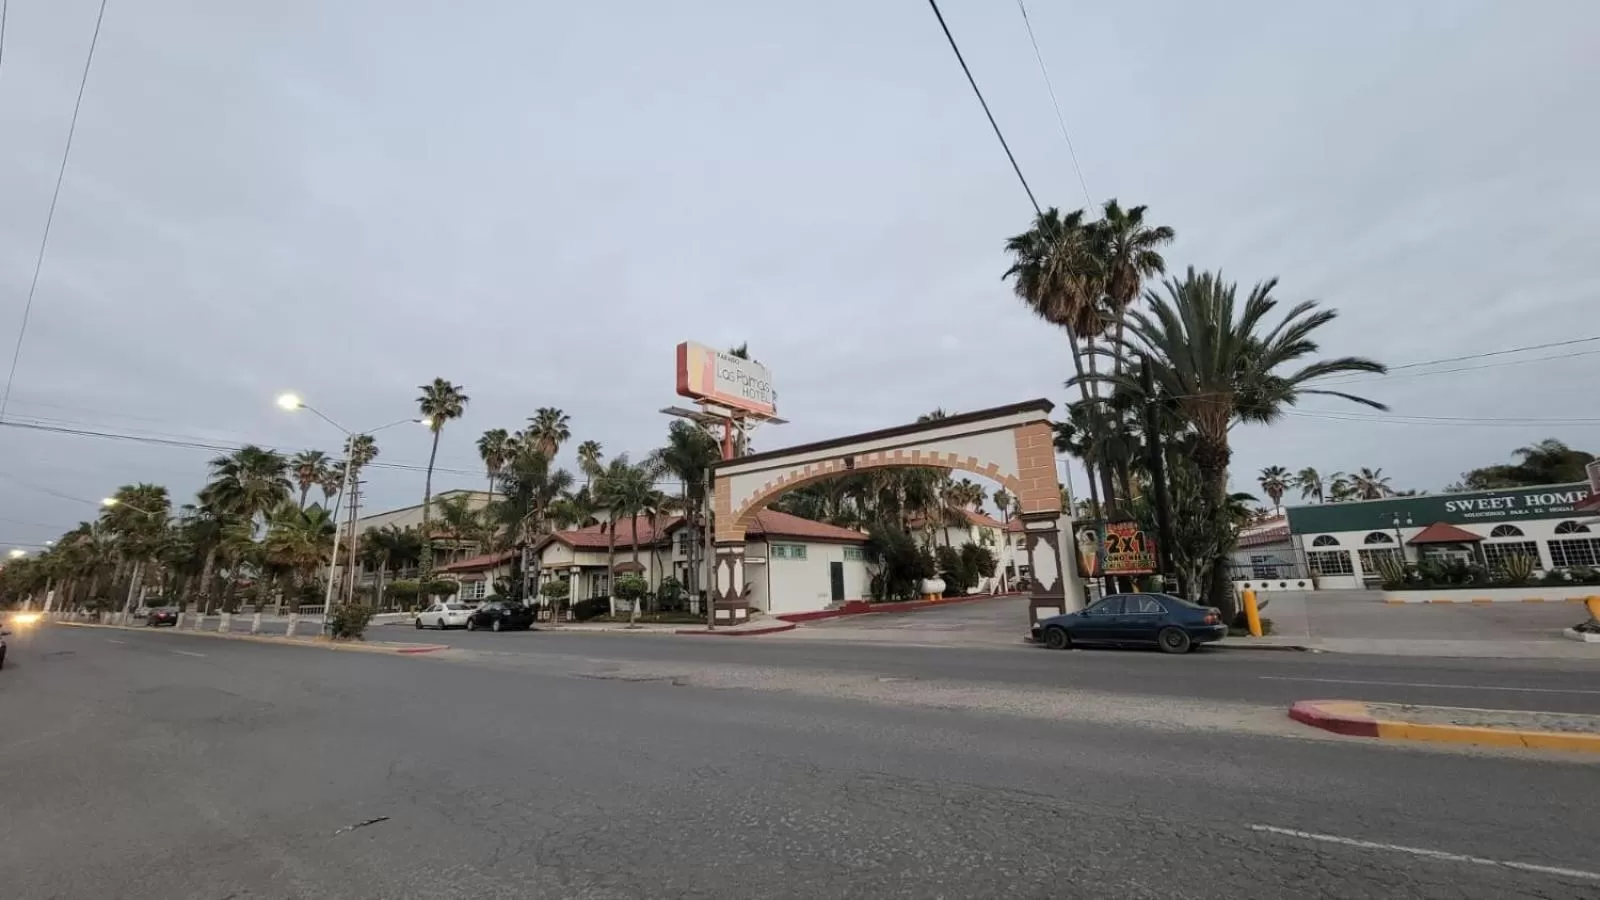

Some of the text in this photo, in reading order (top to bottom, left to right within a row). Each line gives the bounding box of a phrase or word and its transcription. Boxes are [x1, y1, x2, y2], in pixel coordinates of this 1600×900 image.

[717, 363, 770, 393] Las Palmas
[743, 387, 771, 403] HOTEL
[1445, 496, 1515, 512] SWEET
